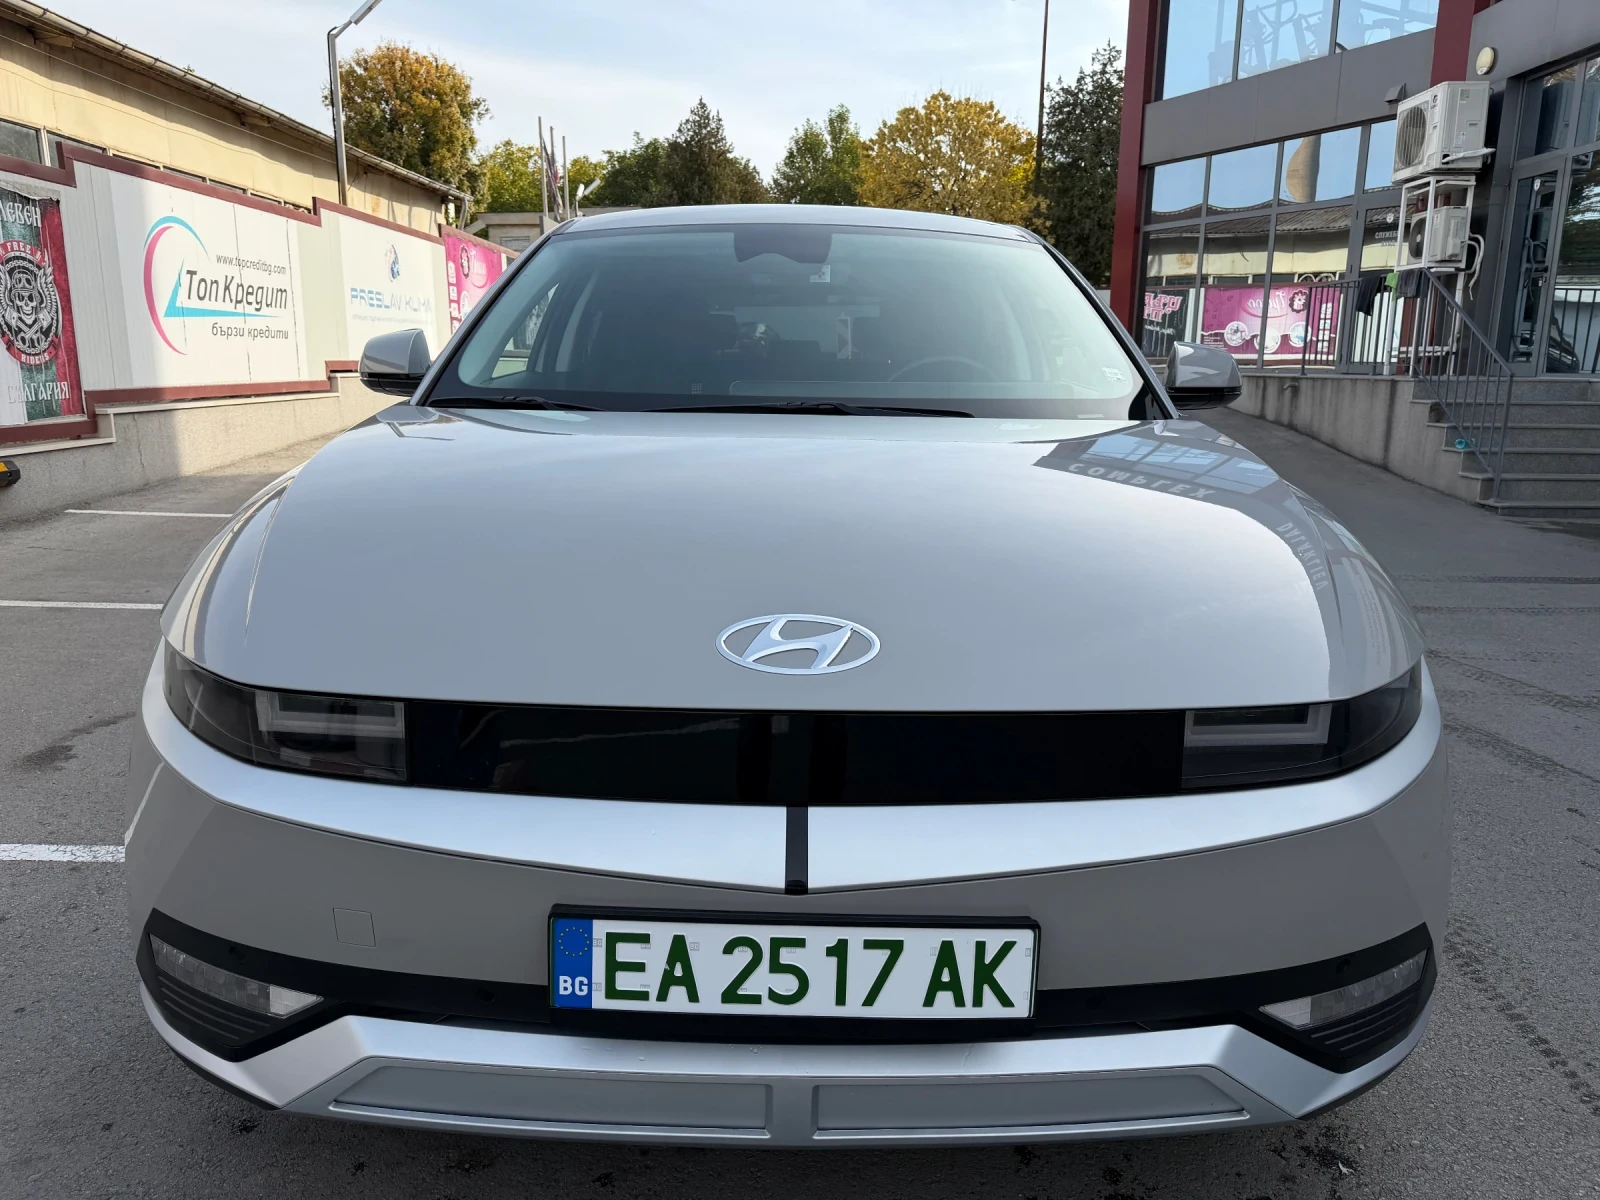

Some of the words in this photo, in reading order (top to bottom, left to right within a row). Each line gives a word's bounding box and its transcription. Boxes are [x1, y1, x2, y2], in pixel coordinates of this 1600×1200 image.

[6, 241, 32, 254] FREE
[215, 254, 287, 275] www.topcreditbg.com
[350, 287, 402, 311] PRESLAV
[211, 322, 244, 339] бързи
[247, 326, 289, 341] кредити
[605, 932, 699, 1003] EA
[721, 937, 904, 1006] 2517
[923, 941, 1016, 1007] AK
[560, 976, 587, 995] BG
